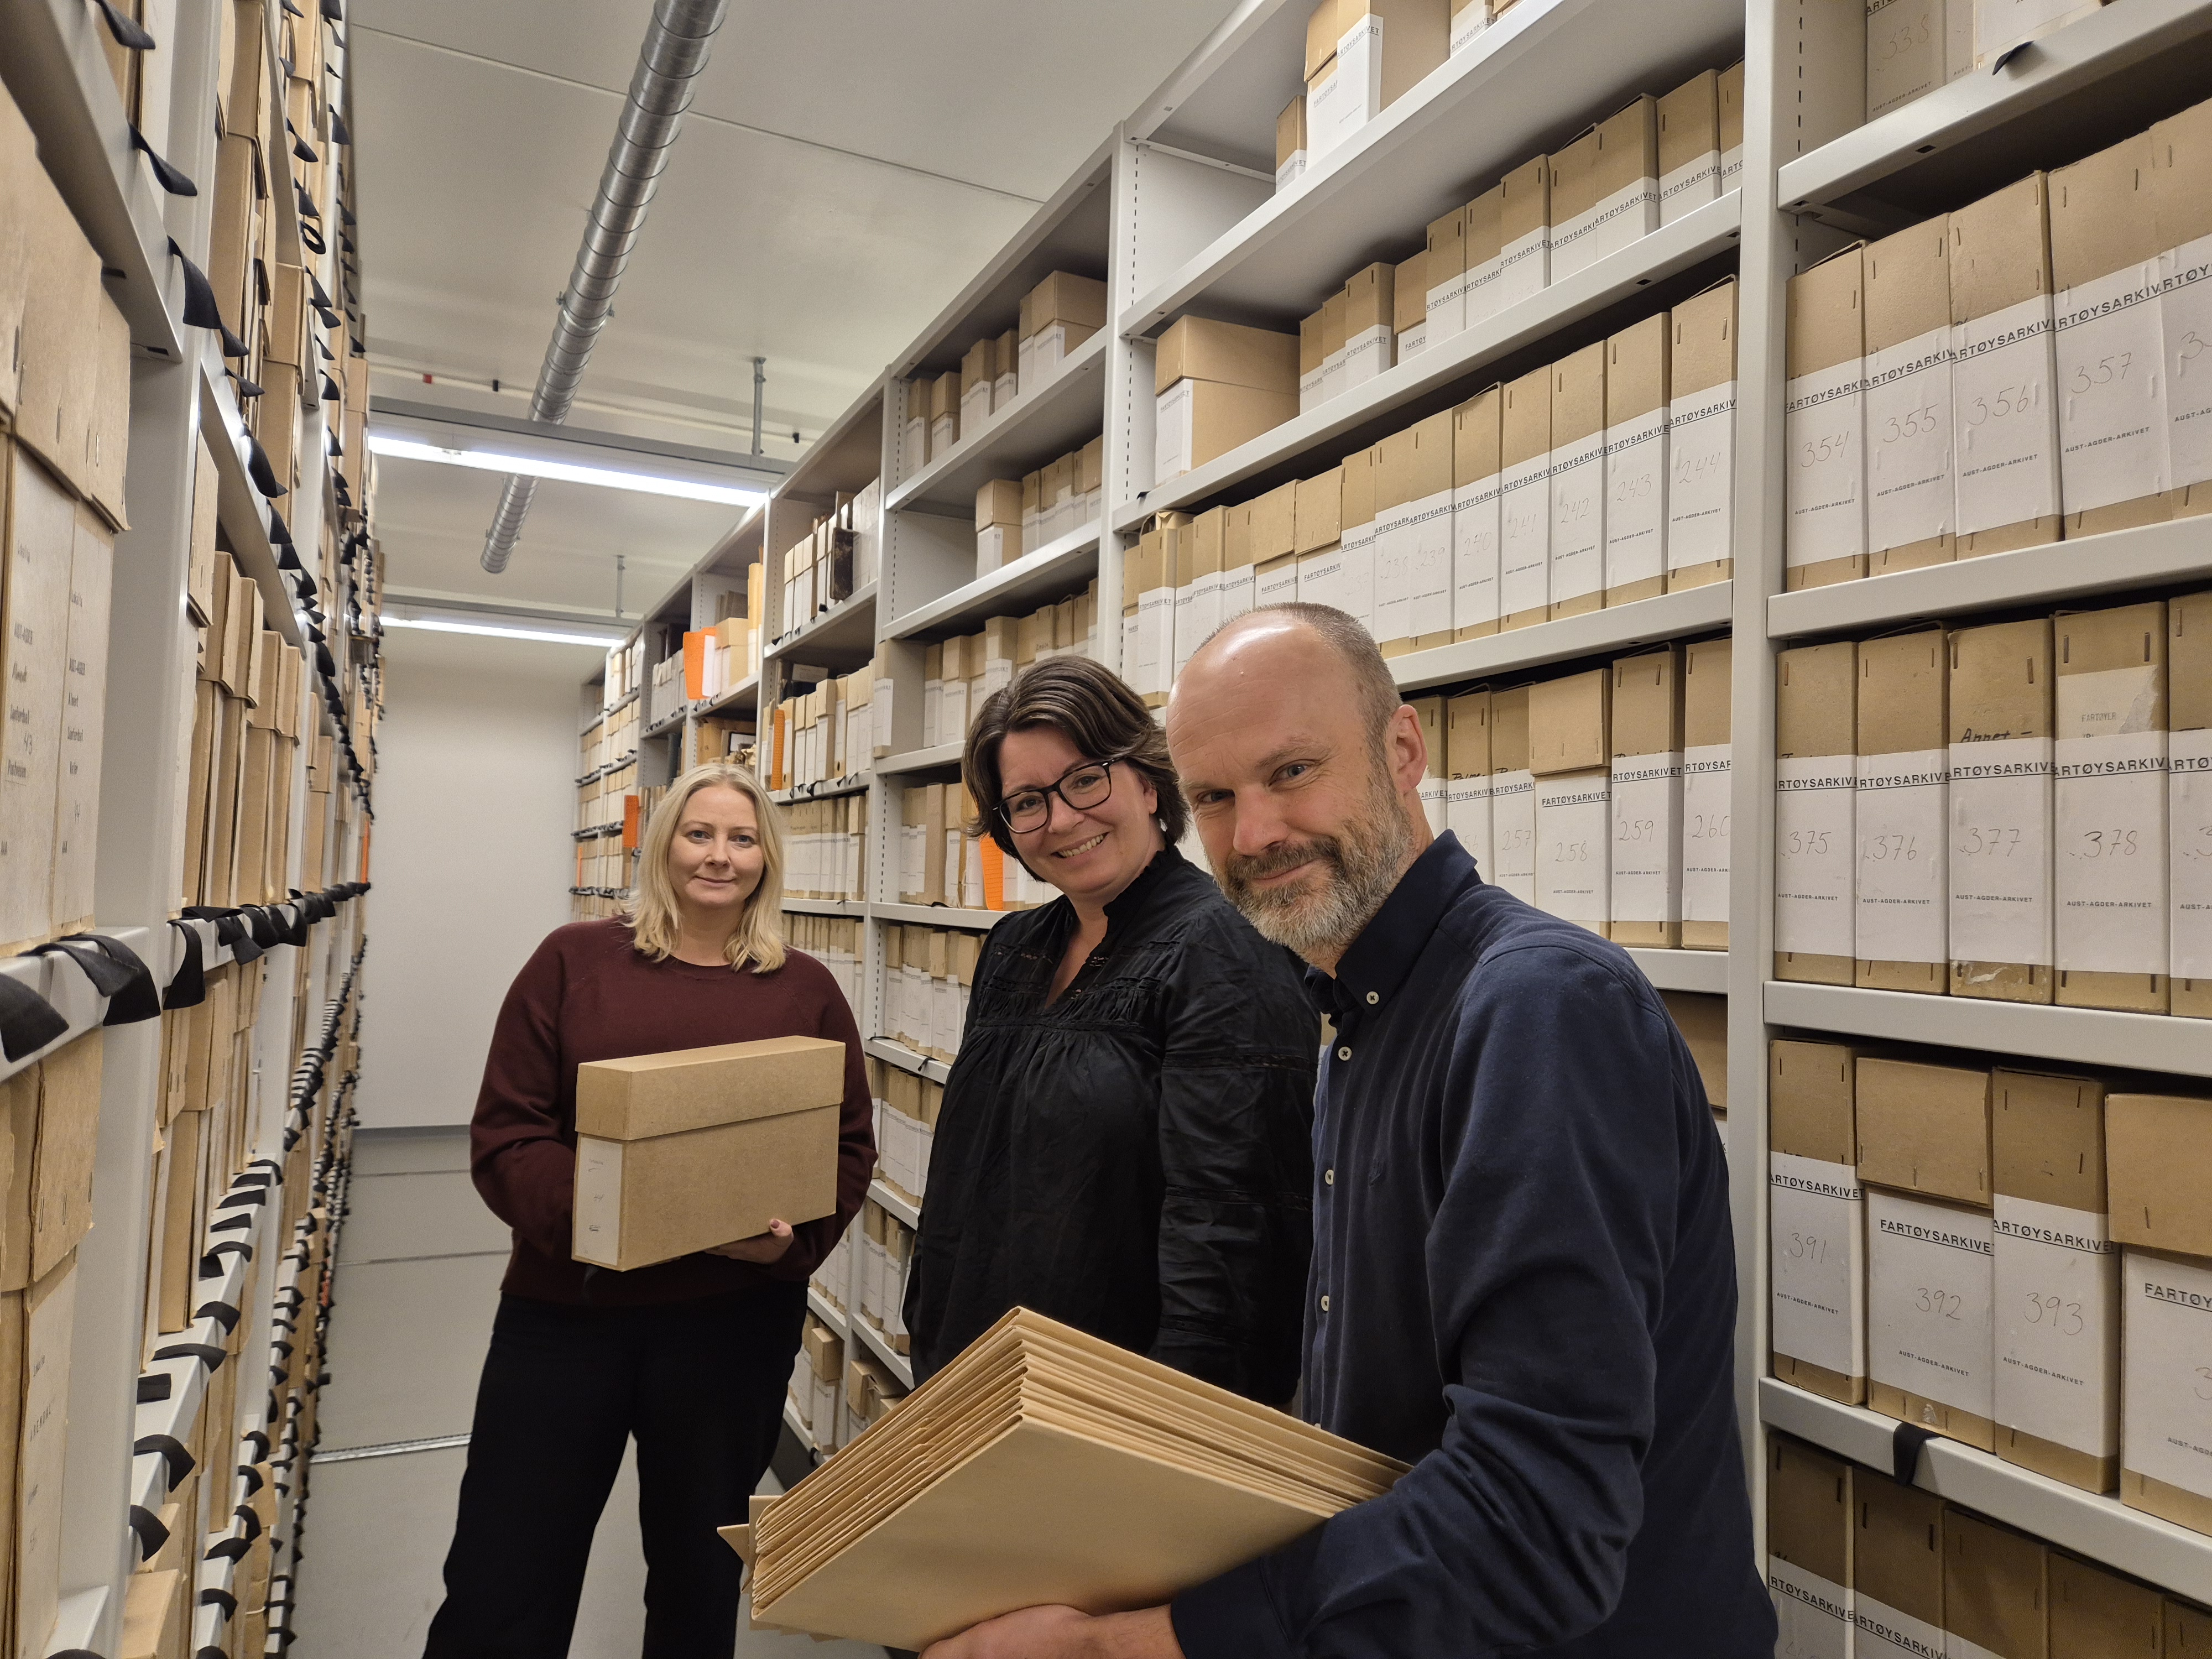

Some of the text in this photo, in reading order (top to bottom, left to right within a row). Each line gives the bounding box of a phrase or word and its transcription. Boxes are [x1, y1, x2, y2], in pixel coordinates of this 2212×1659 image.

[2072, 352, 2132, 394] 357
[1968, 385, 2028, 425] 356
[1883, 404, 1939, 442] 355
[1801, 431, 1849, 468] 354
[2065, 427, 2150, 452] AUST-AGDER-ARKIVET
[1679, 452, 1721, 484] 244
[1616, 473, 1651, 502] 243
[1857, 772, 1949, 789] RTØYSARKIVE
[1619, 820, 1653, 842] 259
[1789, 831, 1832, 854] 375
[1964, 828, 2021, 857] 377
[2084, 830, 2137, 857] 378
[1874, 835, 1917, 860] 376
[1790, 1233, 1827, 1264] 391
[1881, 1219, 1995, 1253] FARTØYSARKIVE
[1916, 1288, 1961, 1320] 392
[2024, 1292, 2084, 1335] 393
